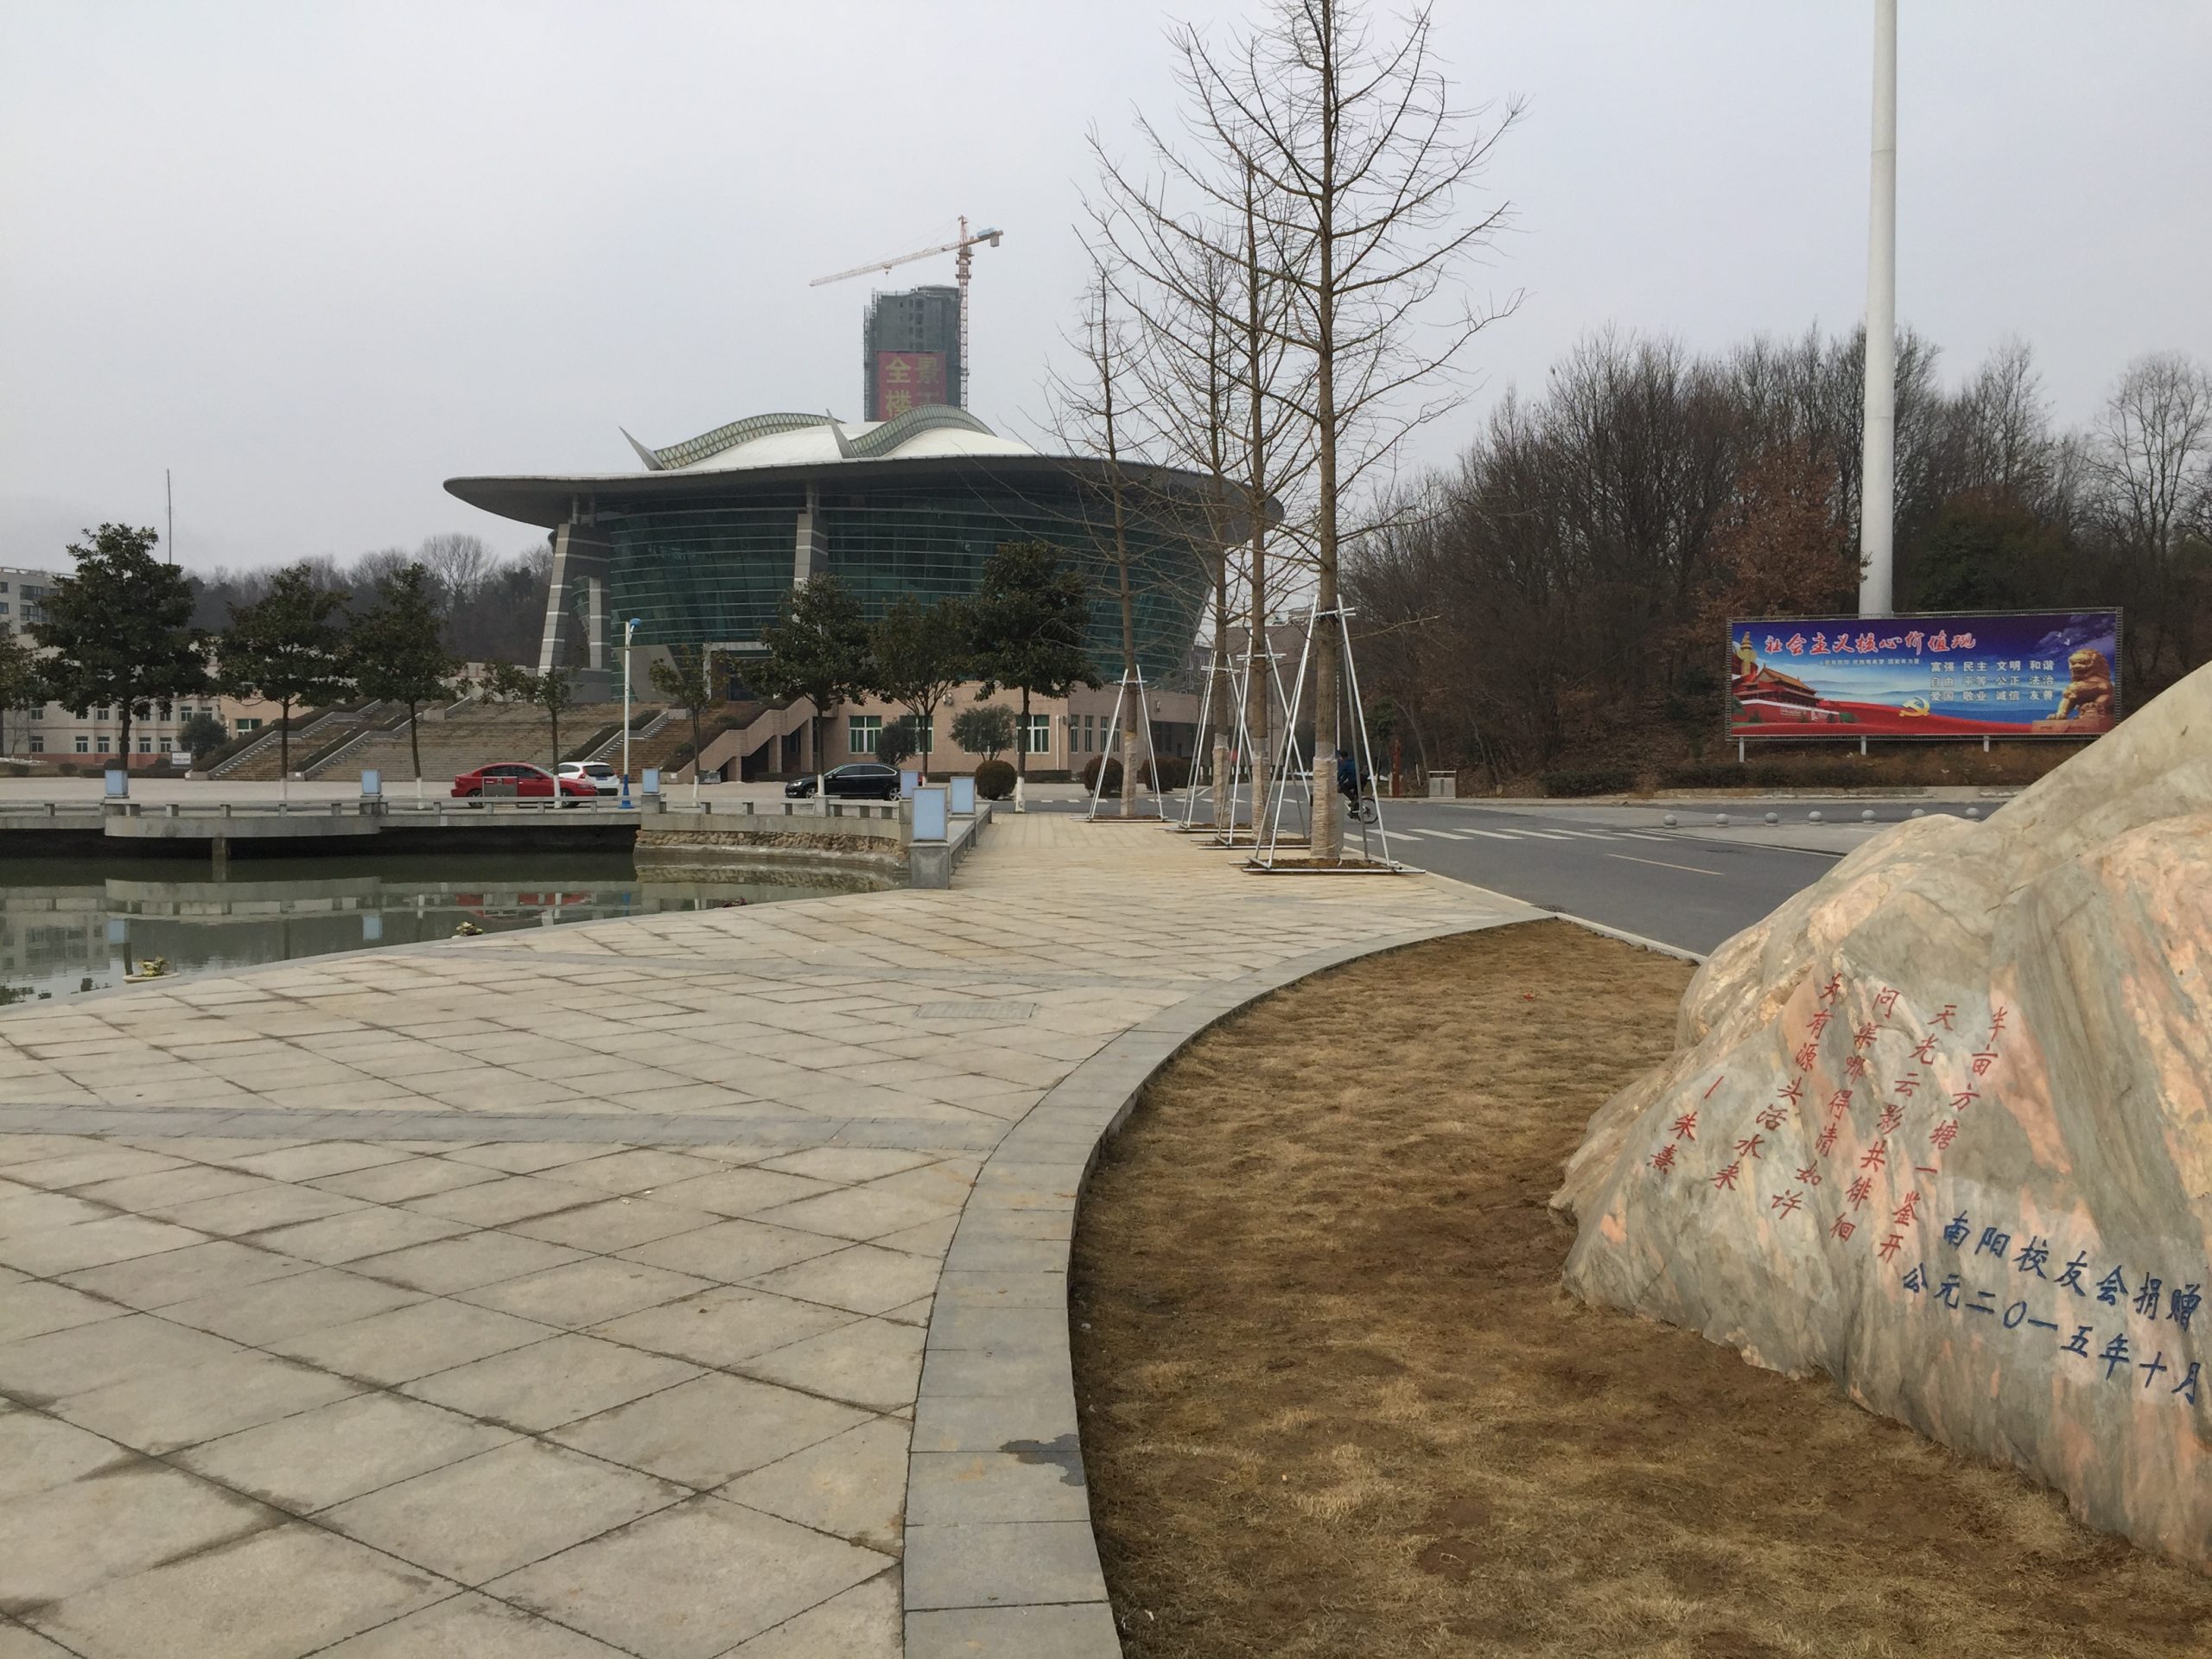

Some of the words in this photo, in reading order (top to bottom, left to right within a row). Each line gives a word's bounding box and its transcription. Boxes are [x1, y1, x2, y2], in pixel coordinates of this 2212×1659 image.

[885, 355, 940, 384] 全景
[1930, 661, 1955, 672] 富强
[1963, 661, 1987, 672] 民主
[1996, 660, 2021, 671] 文明
[2030, 659, 2055, 671] 和谐
[1930, 677, 1955, 688] 自由
[1963, 676, 1987, 687] 平等
[1996, 676, 2020, 686] 公正
[2030, 675, 2054, 686] 法治
[1930, 690, 1955, 702] 爱国
[1963, 690, 1987, 702] 敬业
[1996, 690, 2020, 701] 诚信
[2030, 690, 2054, 701] 友善
[1710, 971, 1843, 1192] 为有源头活水来
[1829, 1004, 1958, 1243] 天光云影共徘徊
[1878, 1006, 2009, 1264] 半亩方塘一鉴开
[1943, 1209, 2202, 1332] 南阳校友会捐赠
